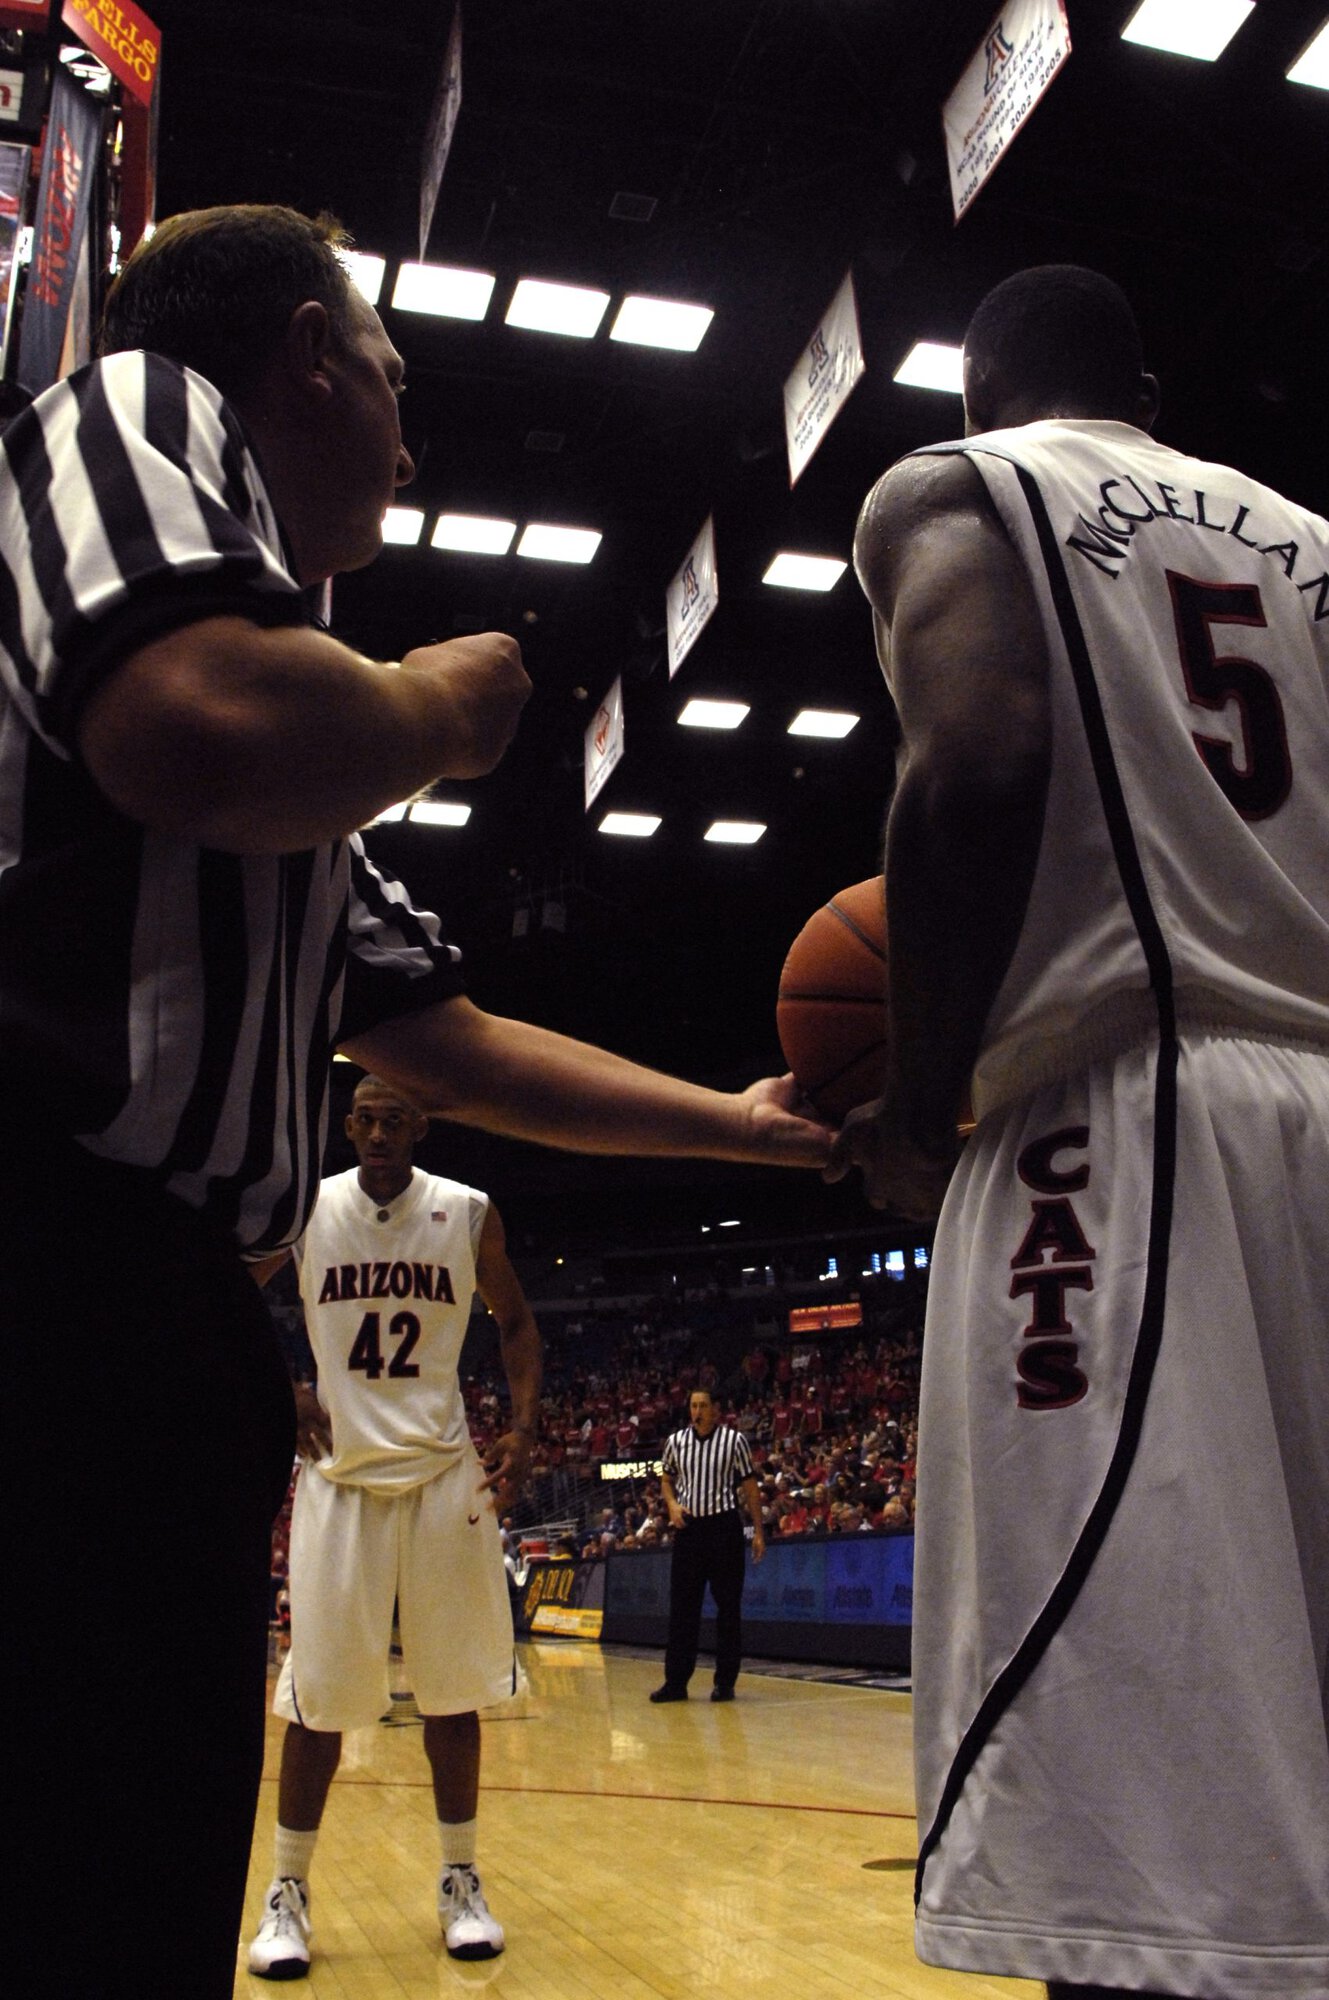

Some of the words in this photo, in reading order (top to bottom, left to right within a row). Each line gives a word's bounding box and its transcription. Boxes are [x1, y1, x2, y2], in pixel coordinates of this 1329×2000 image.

[958, 175, 978, 209] 2000
[984, 136, 1004, 169] 2001
[1010, 94, 1032, 131] 2002
[1039, 47, 1062, 87] 2005
[1164, 568, 1293, 822] 5
[318, 1261, 456, 1305] ARIZONA
[348, 1311, 420, 1379] 42
[1009, 1125, 1096, 1411] CATS
